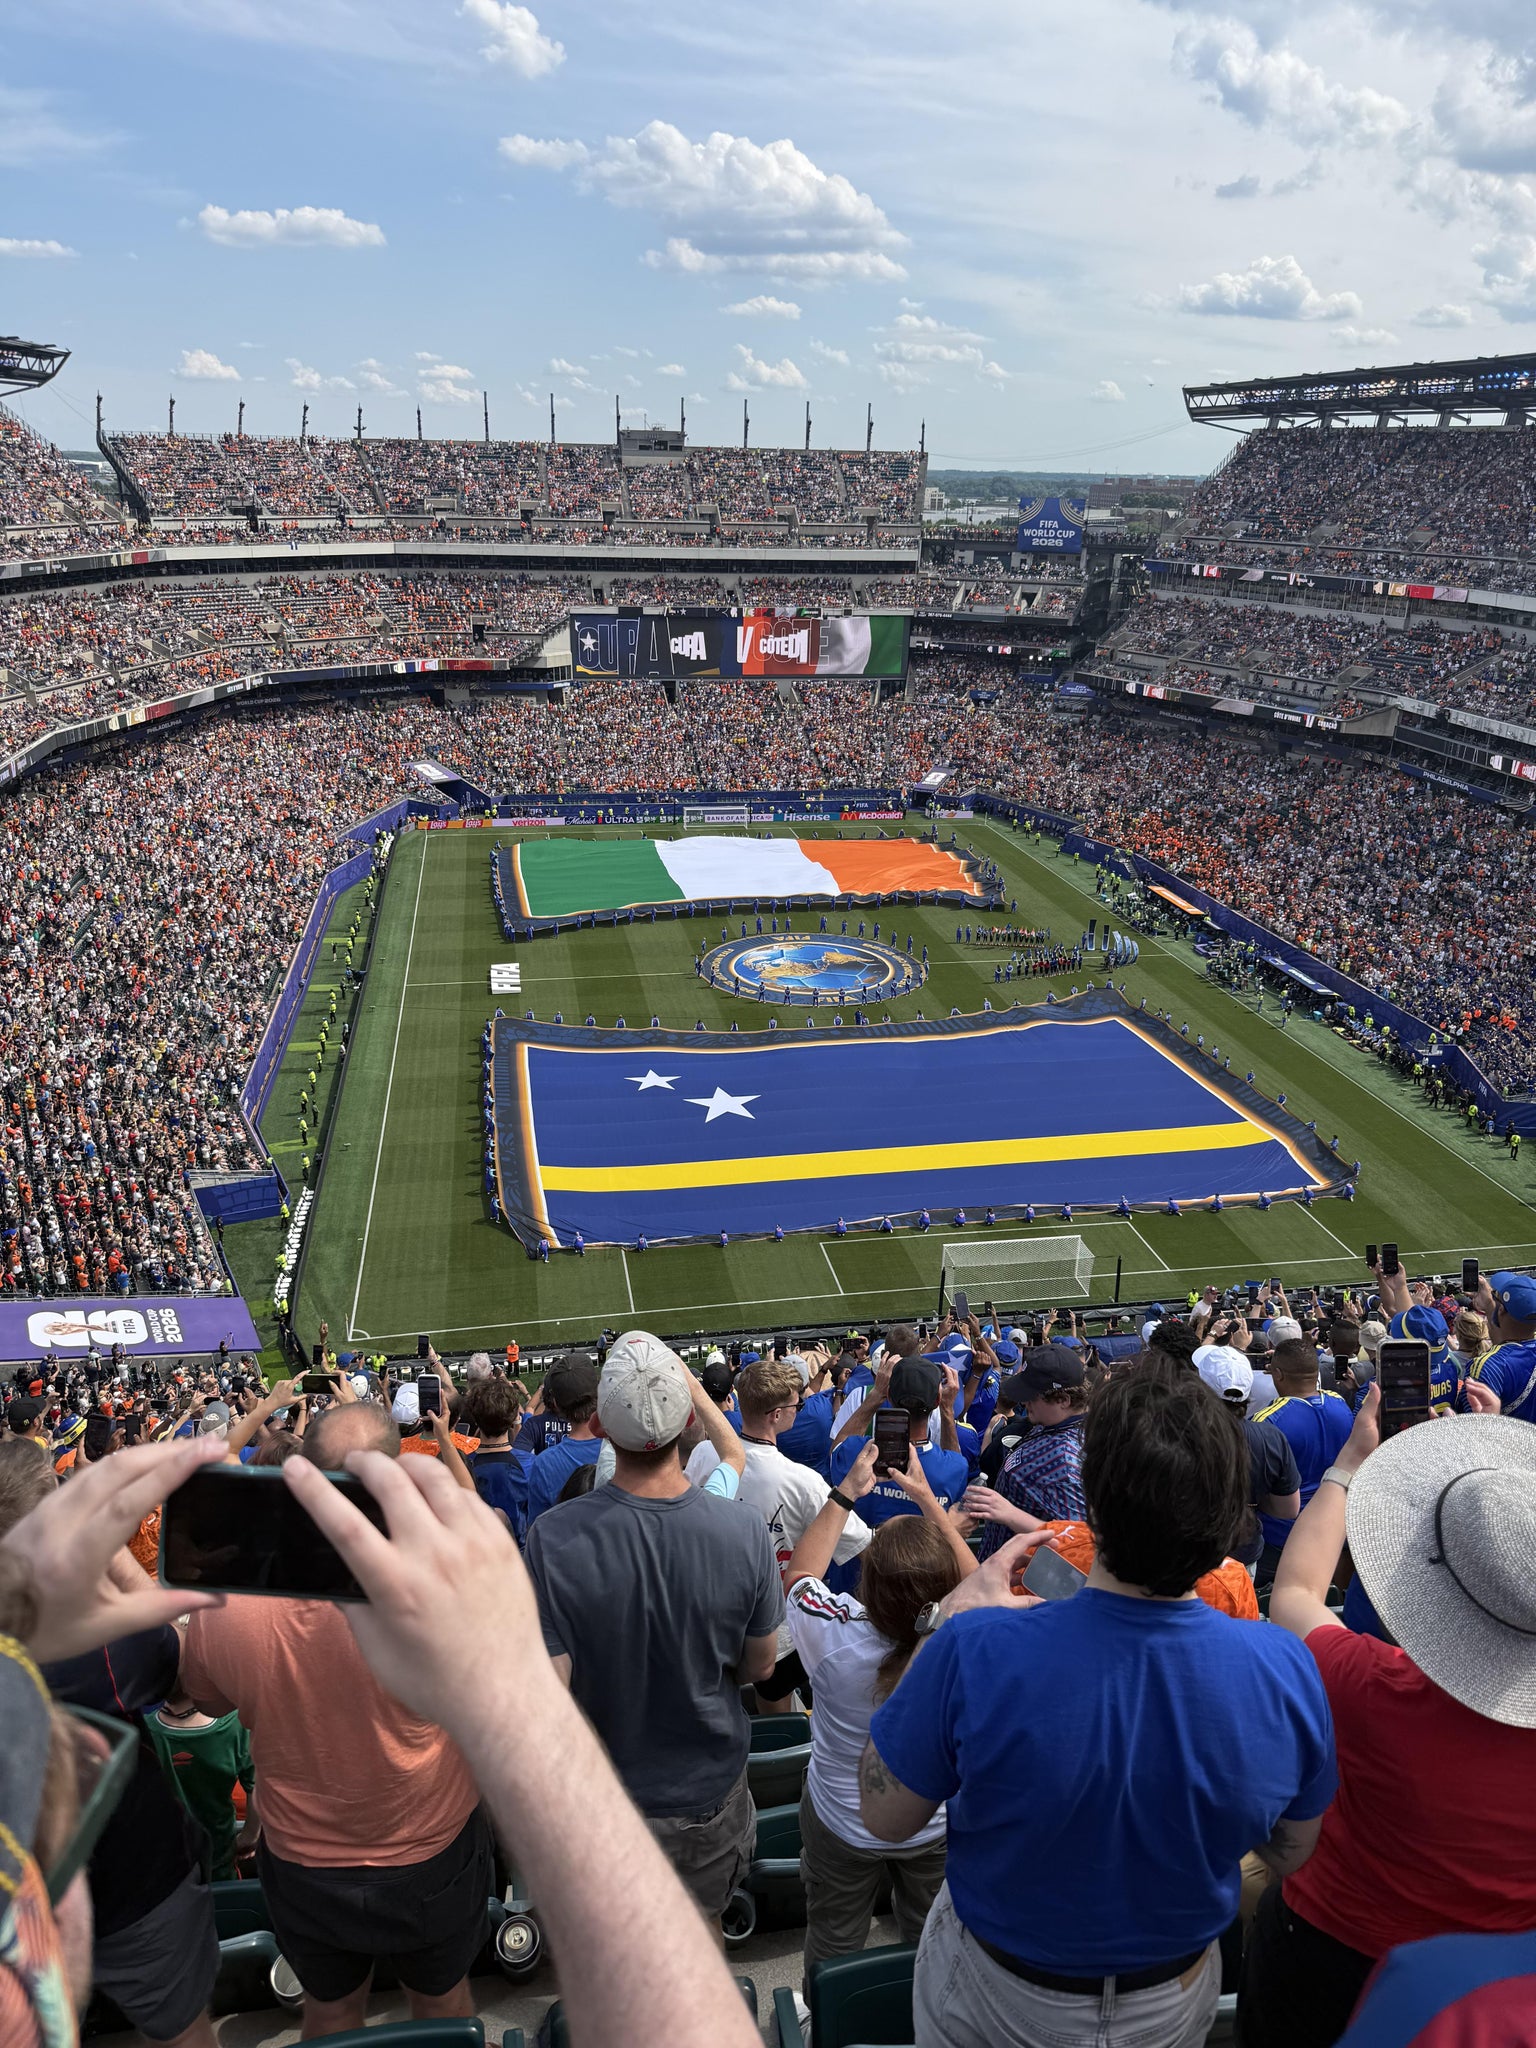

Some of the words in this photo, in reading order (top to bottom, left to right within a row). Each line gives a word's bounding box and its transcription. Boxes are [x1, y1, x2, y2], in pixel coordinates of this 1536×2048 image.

[1039, 520, 1059, 529] FIFA
[1023, 528, 1055, 538] WORLD
[1056, 530, 1076, 539] CUP
[1031, 538, 1064, 547] 2026
[360, 685, 411, 695] PHILADELPHIA
[1159, 711, 1203, 724] PHILADELPHIA
[1423, 771, 1469, 792] PHILADELPHIA
[512, 818, 546, 827] verizon
[604, 815, 635, 824] ULTRA
[783, 813, 830, 821] Hisense
[146, 1308, 159, 1321] CUP
[122, 1318, 136, 1334] FIFA
[159, 1308, 184, 1343] 2026
[150, 1321, 165, 1343] WORLD
